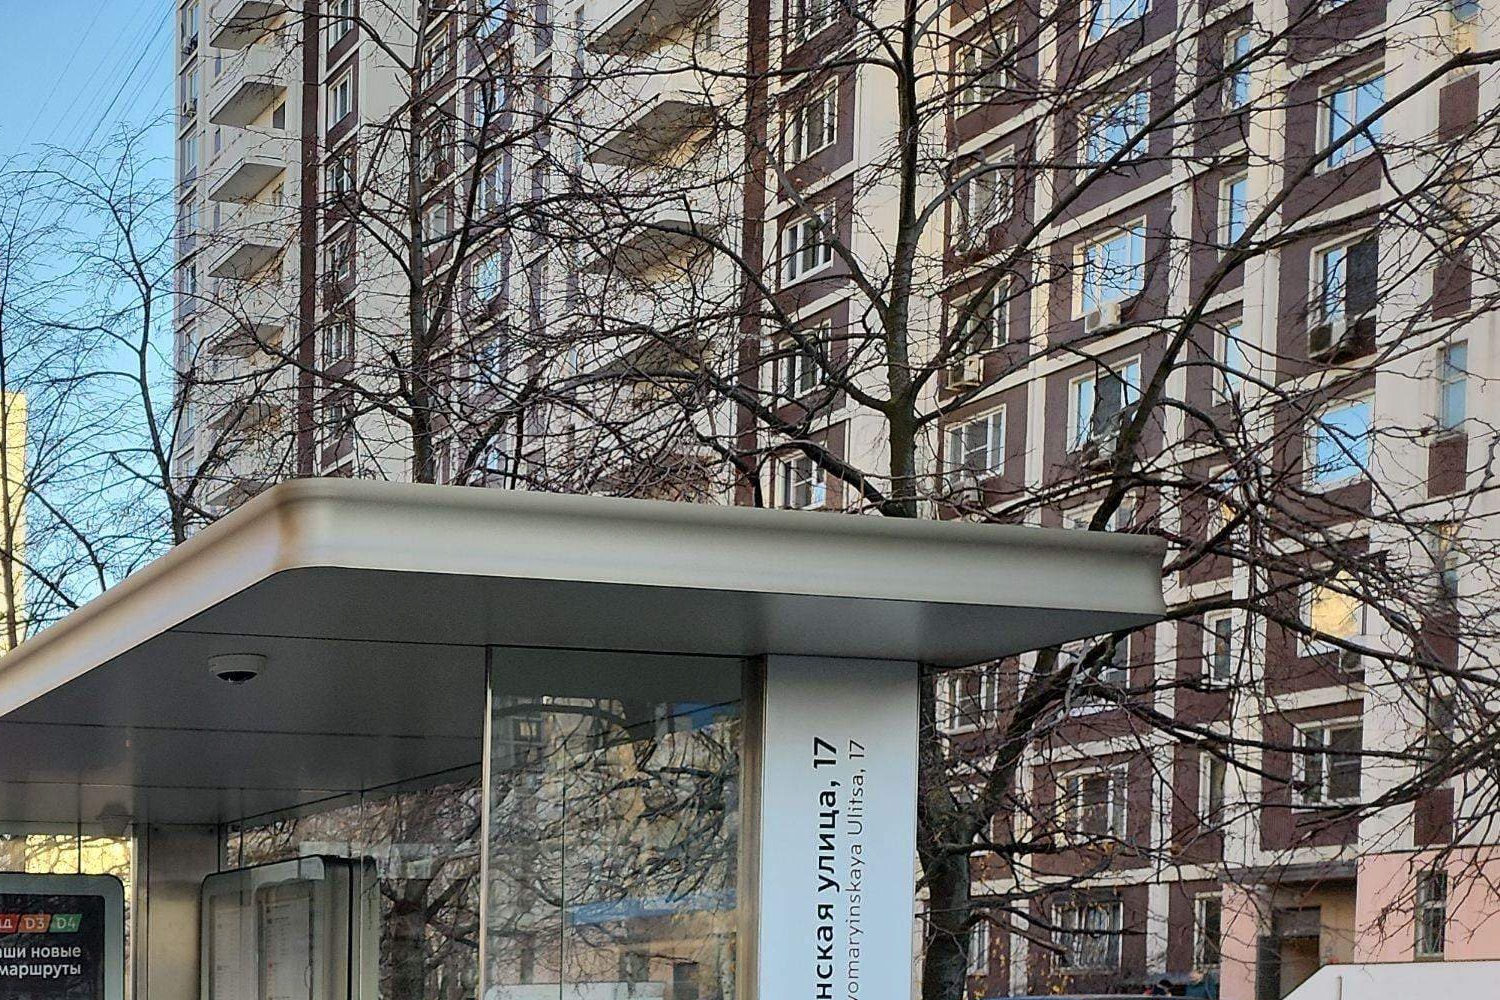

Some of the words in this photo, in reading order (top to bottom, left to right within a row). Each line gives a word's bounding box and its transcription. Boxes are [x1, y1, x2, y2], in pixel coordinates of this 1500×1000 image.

[813, 736, 837, 768] 17
[848, 739, 866, 760] 17
[847, 767, 866, 836] Ulitsa,
[816, 778, 841, 893] улица,
[26, 917, 44, 929] D3
[56, 917, 76, 929] D4
[31, 946, 81, 958] новые
